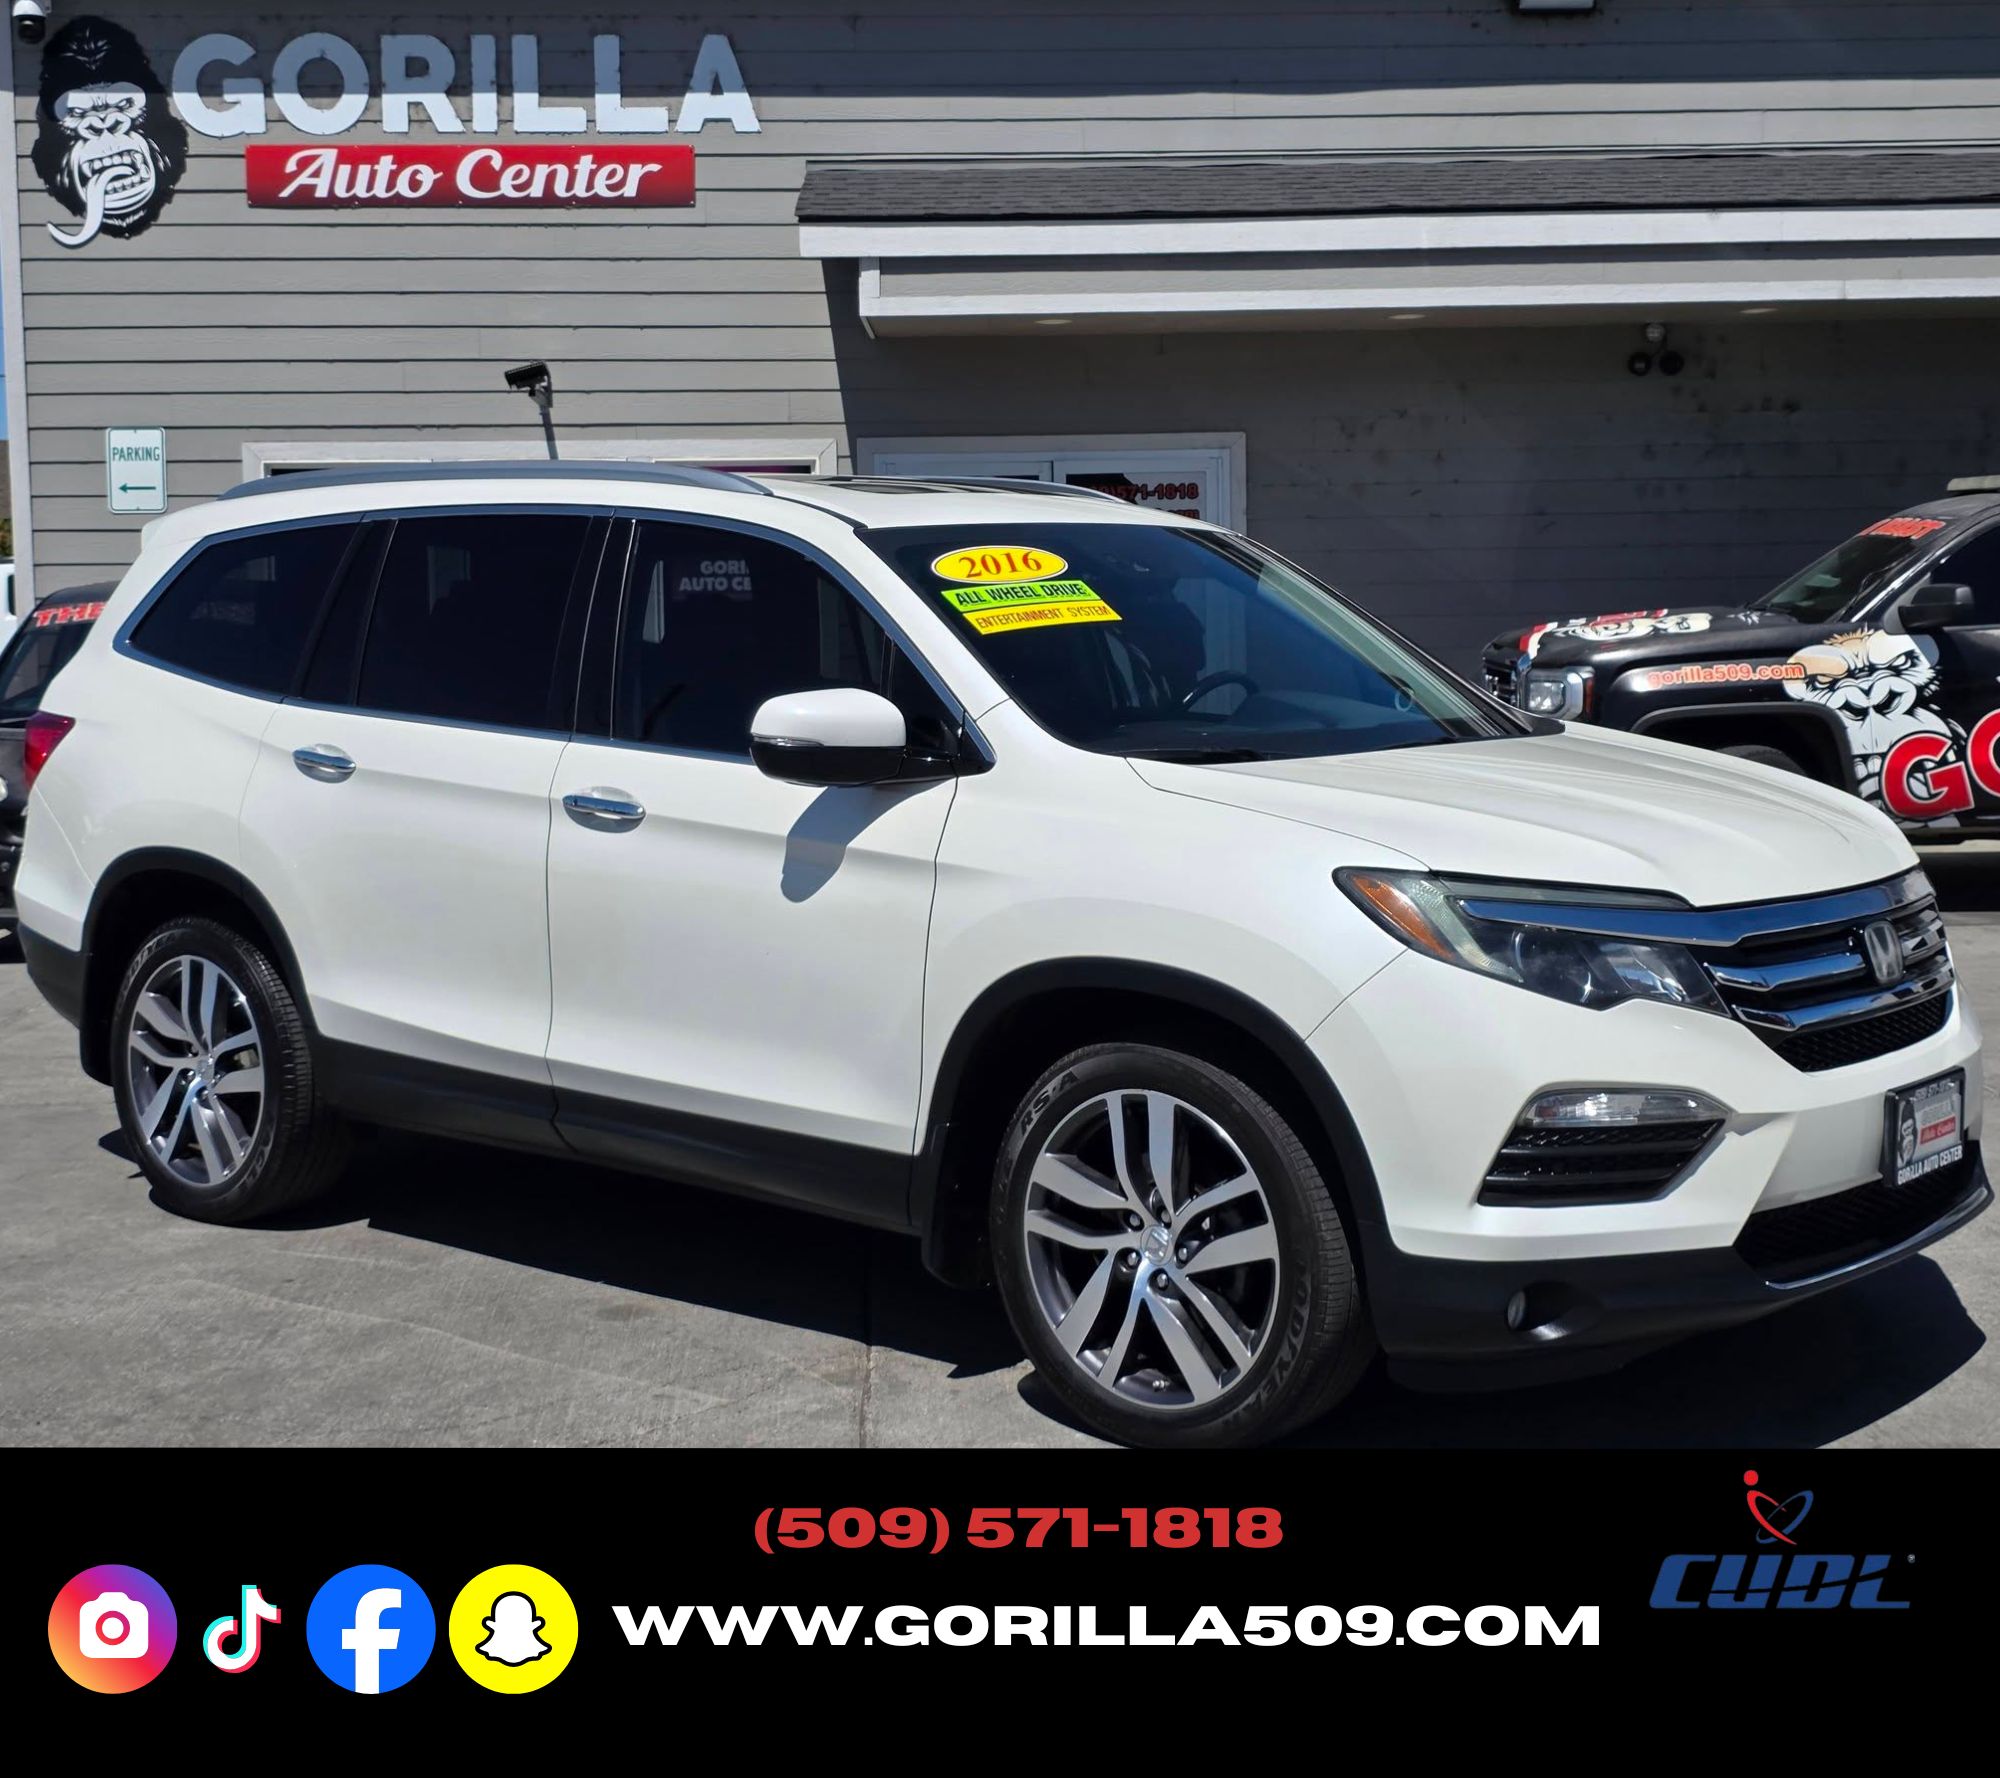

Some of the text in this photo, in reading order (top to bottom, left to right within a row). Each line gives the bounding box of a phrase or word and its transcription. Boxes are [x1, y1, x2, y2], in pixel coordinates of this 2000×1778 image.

[172, 32, 762, 137] GORILLA
[279, 148, 662, 200] Auto Center
[112, 446, 160, 462] PARKING
[700, 560, 750, 575] GORI
[958, 550, 1042, 579] 2016
[679, 577, 729, 592] AUTO
[955, 583, 1084, 606] ALL WHEEL DRIVE
[975, 605, 1111, 629] ENTERTAINMENT SYSTEM
[1647, 663, 1805, 689] gorilla509.com
